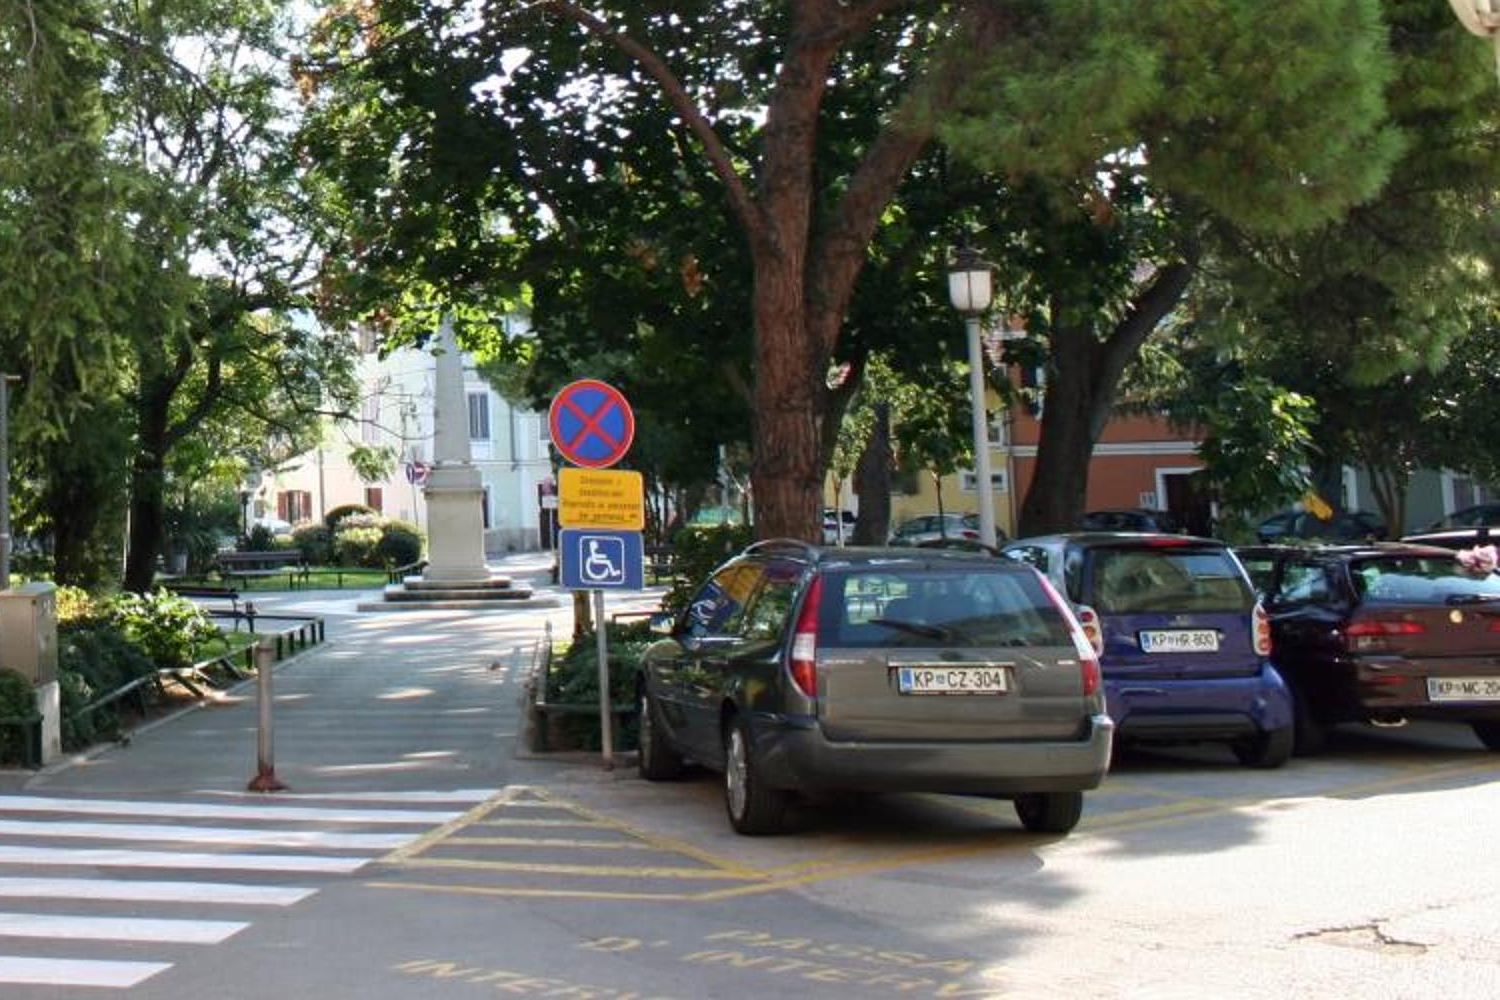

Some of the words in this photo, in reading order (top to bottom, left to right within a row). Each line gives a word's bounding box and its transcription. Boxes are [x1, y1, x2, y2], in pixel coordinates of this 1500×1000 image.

[1152, 633, 1166, 647] KP
[914, 670, 935, 688] KP
[947, 670, 1002, 689] CZ-304
[1462, 680, 1500, 696] MC-20
